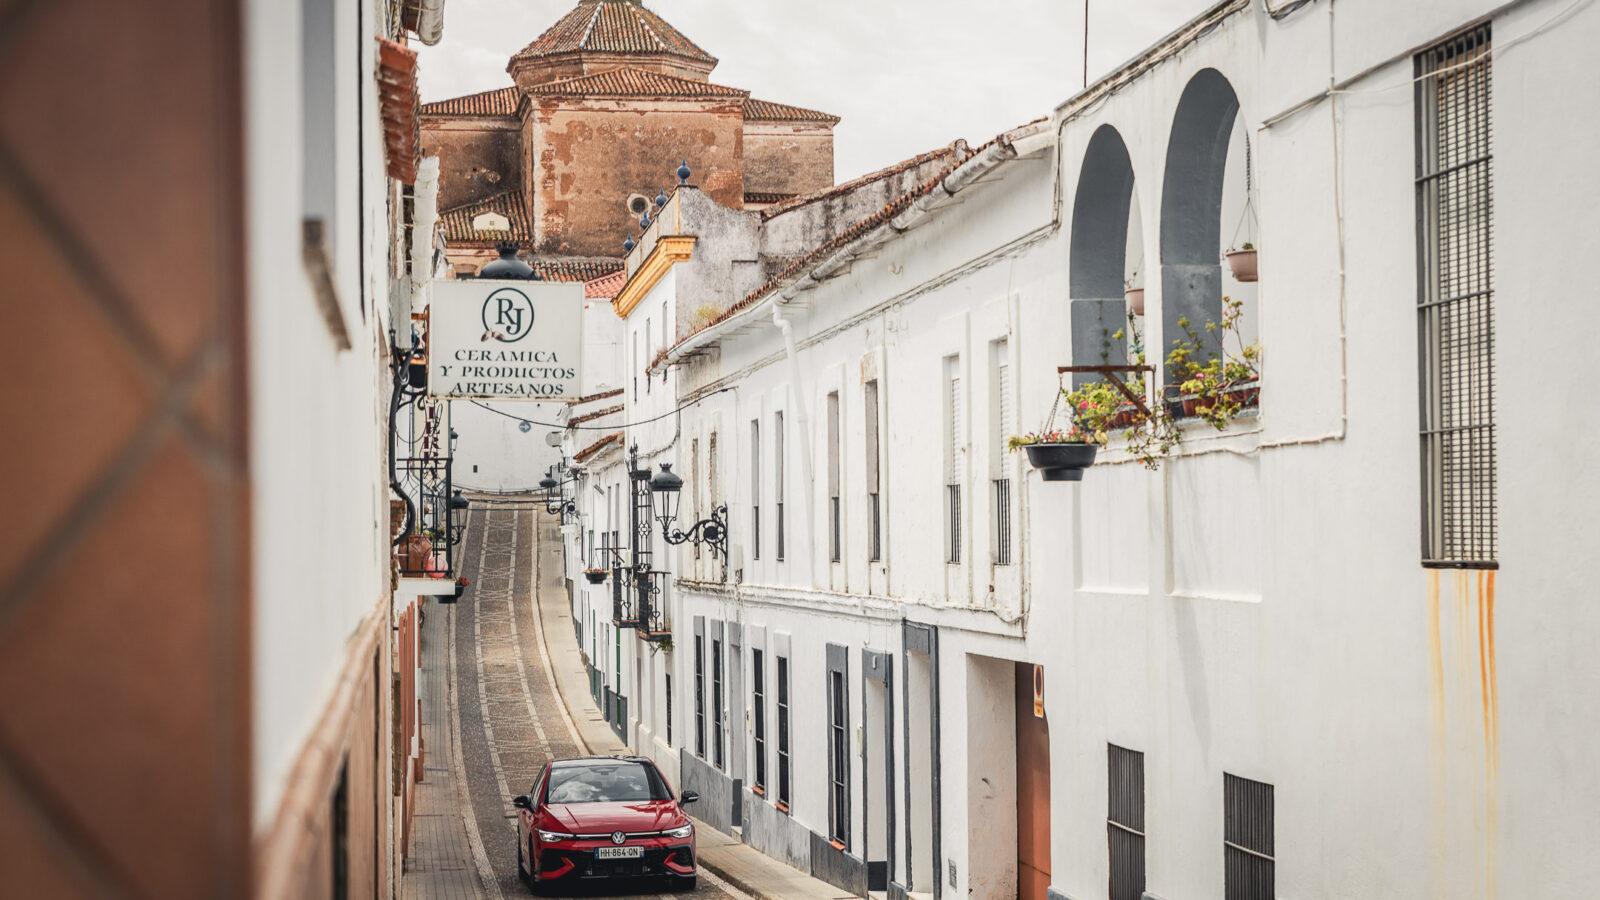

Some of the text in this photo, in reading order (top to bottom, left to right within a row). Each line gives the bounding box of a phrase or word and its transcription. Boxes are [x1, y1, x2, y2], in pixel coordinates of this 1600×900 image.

[495, 298, 525, 335] RJ
[454, 349, 558, 363] CERAMICA
[439, 365, 575, 380] Y PRODUCTOS
[451, 382, 564, 395] ARTESANOS
